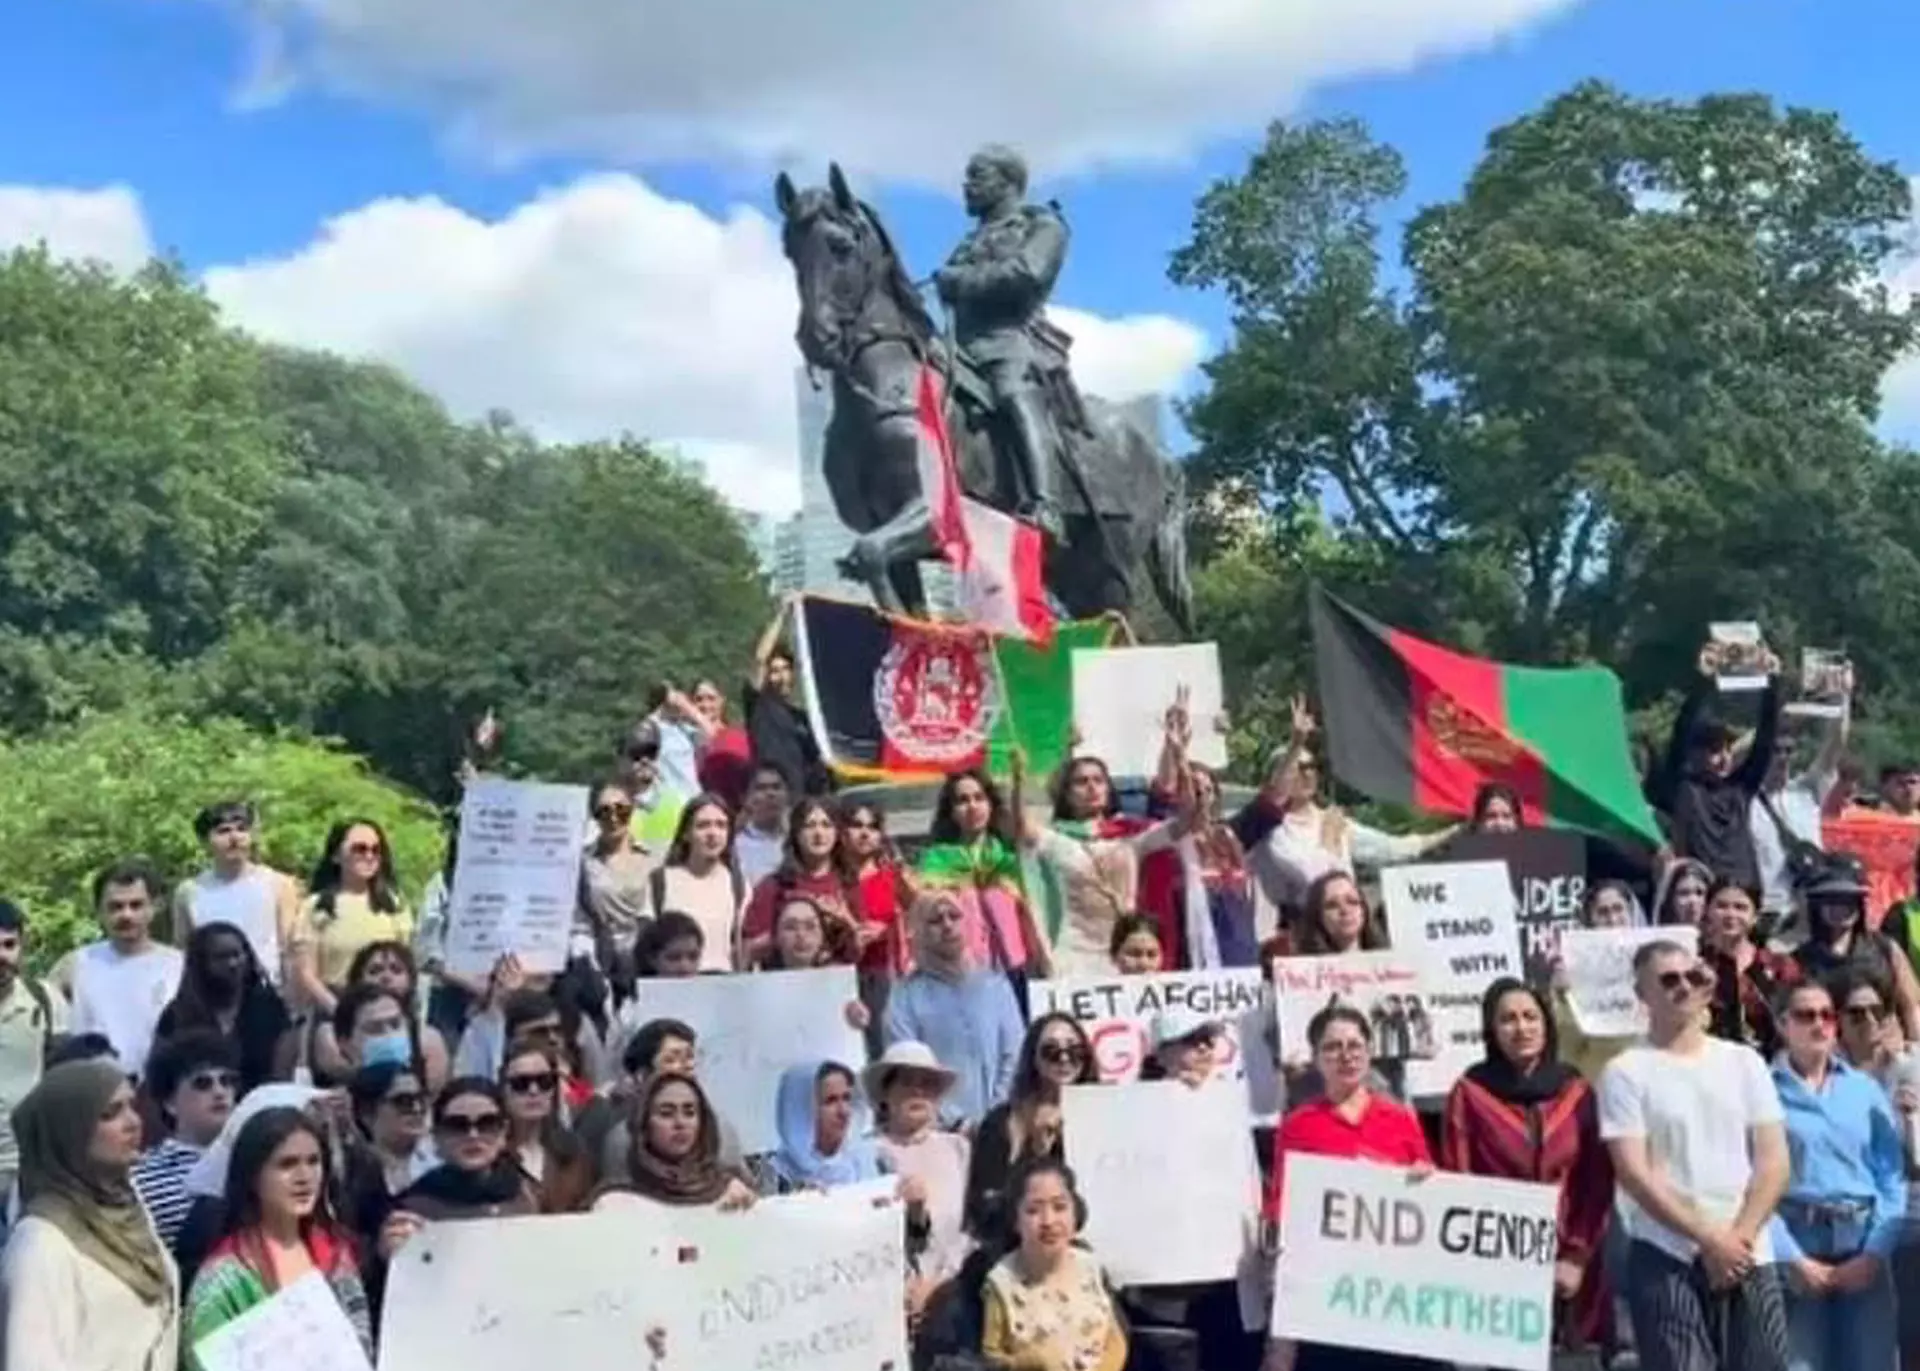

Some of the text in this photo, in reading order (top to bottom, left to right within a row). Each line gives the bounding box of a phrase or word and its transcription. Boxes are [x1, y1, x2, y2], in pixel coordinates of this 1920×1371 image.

[1408, 882, 1447, 903] WE
[1425, 917, 1494, 939] STAND
[1449, 953, 1509, 975] WITH
[1319, 1188, 1425, 1247] END
[1327, 1272, 1545, 1342] APARTHEID
